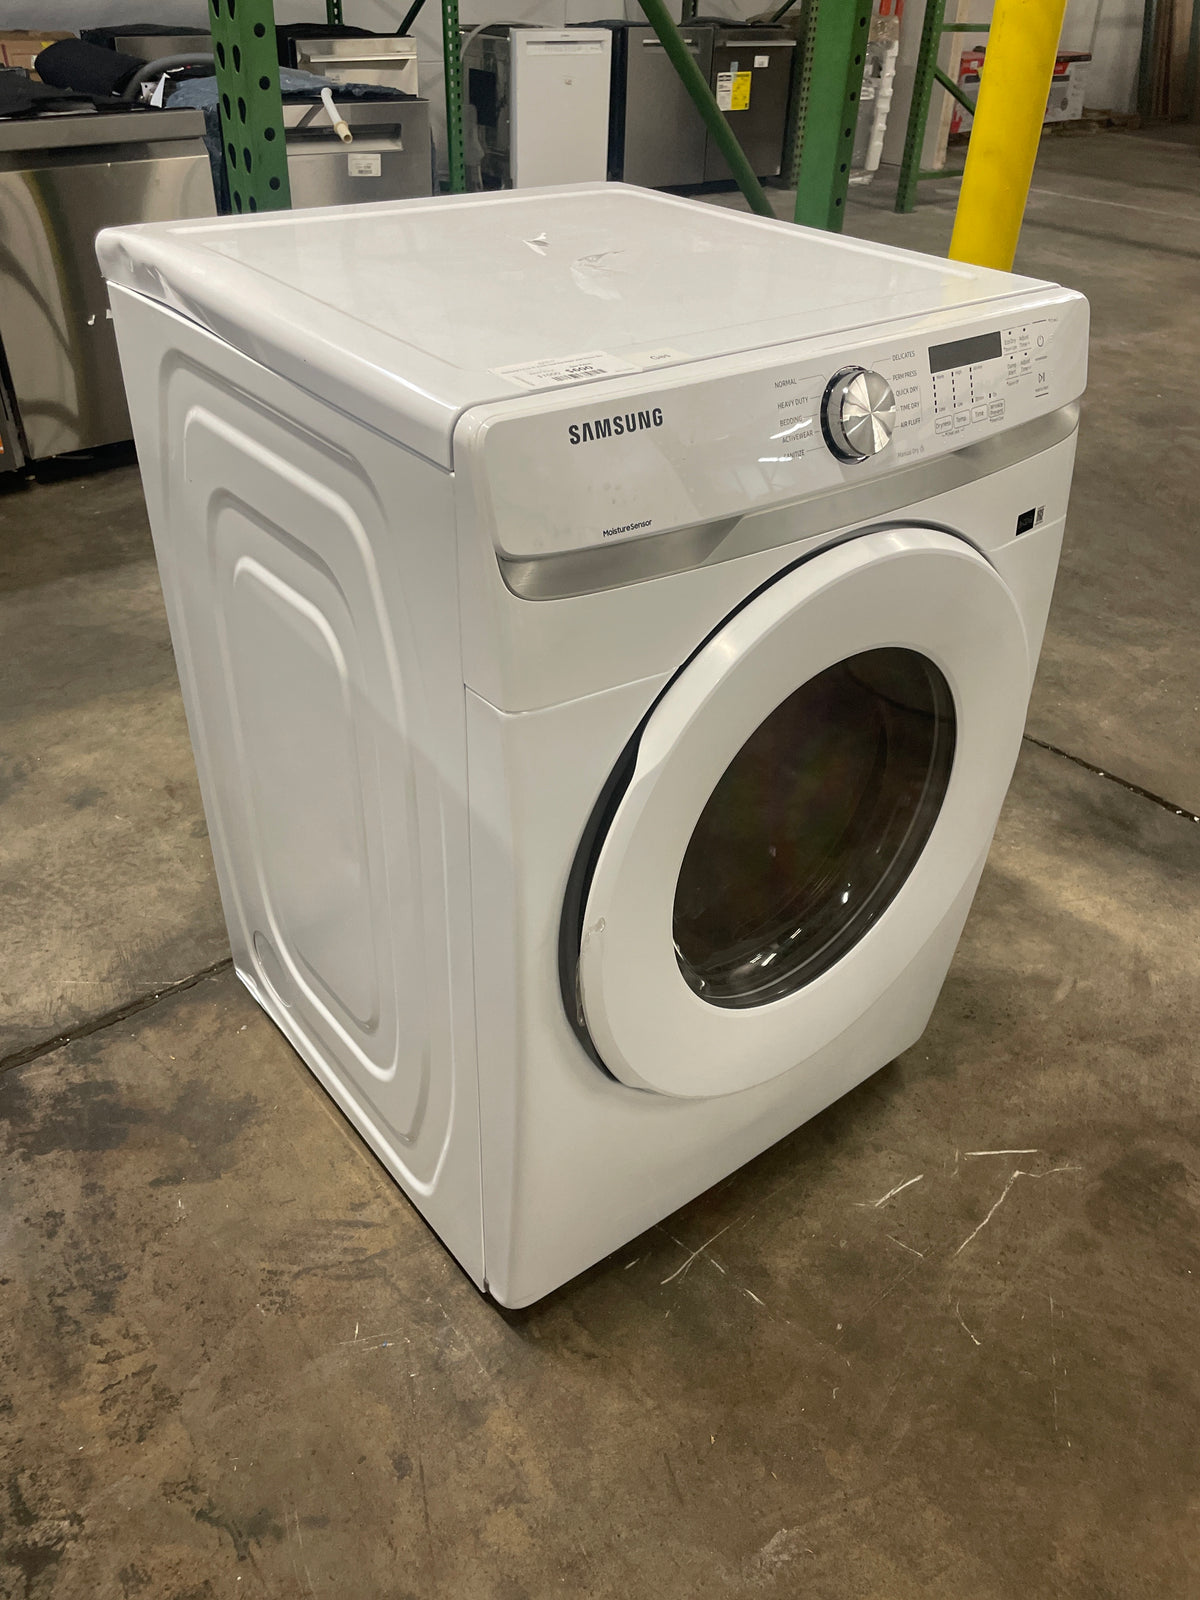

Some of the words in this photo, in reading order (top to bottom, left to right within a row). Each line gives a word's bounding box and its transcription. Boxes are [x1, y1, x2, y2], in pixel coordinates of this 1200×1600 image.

[892, 350, 916, 362] DELICATES
[774, 378, 797, 389] NORMAL
[895, 388, 909, 397] QUICK
[909, 384, 919, 393] DRY
[777, 400, 794, 409] HEAVY
[795, 396, 808, 406] DUTY
[900, 404, 911, 412] TIME
[911, 401, 920, 409] DRY
[568, 407, 663, 445] SAMSUNG
[779, 415, 803, 427] BEDDING
[900, 420, 908, 429] AIR
[908, 417, 921, 426] FLUFF
[782, 429, 813, 443] ACTIVEWEAR
